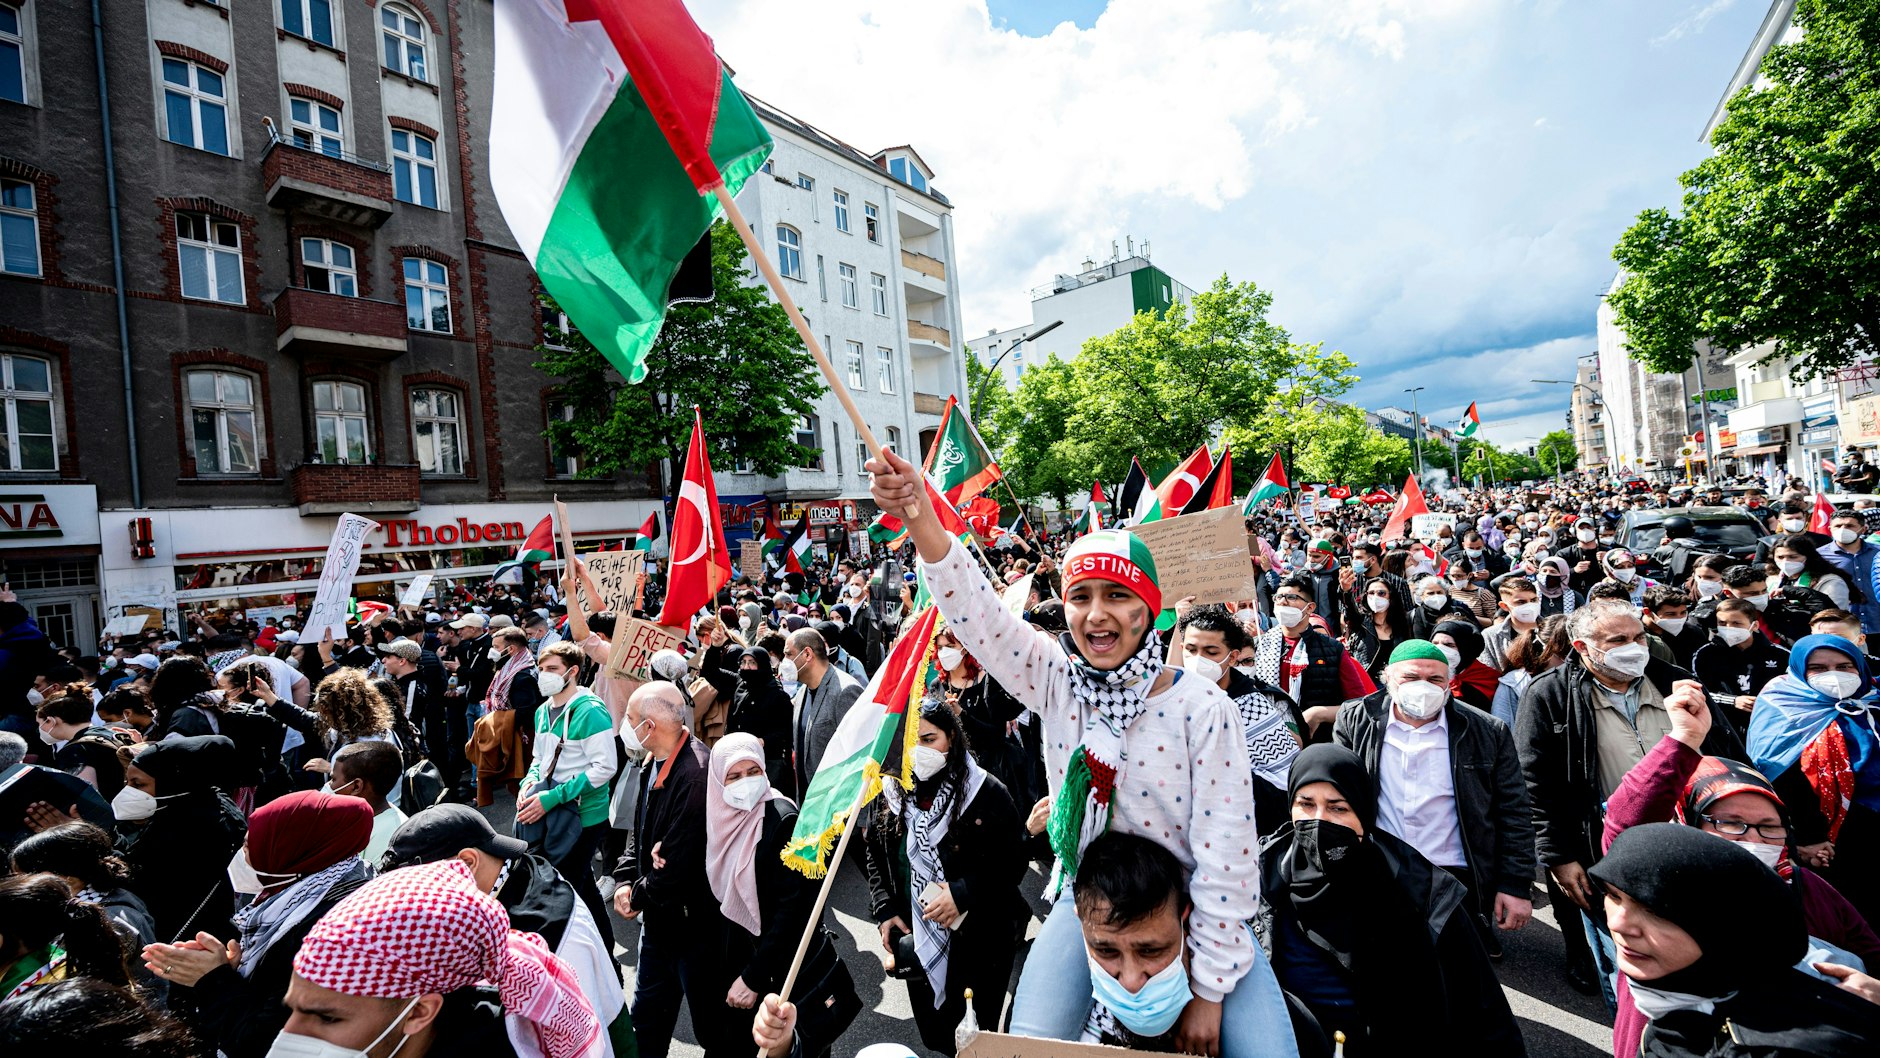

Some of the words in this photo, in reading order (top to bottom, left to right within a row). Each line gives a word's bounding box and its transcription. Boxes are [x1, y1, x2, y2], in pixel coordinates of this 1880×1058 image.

[0, 503, 60, 529] NA
[810, 506, 840, 519] MEDIA
[376, 518, 526, 547] Thoben
[1063, 556, 1142, 584] LESTINE
[633, 625, 676, 652] FREE
